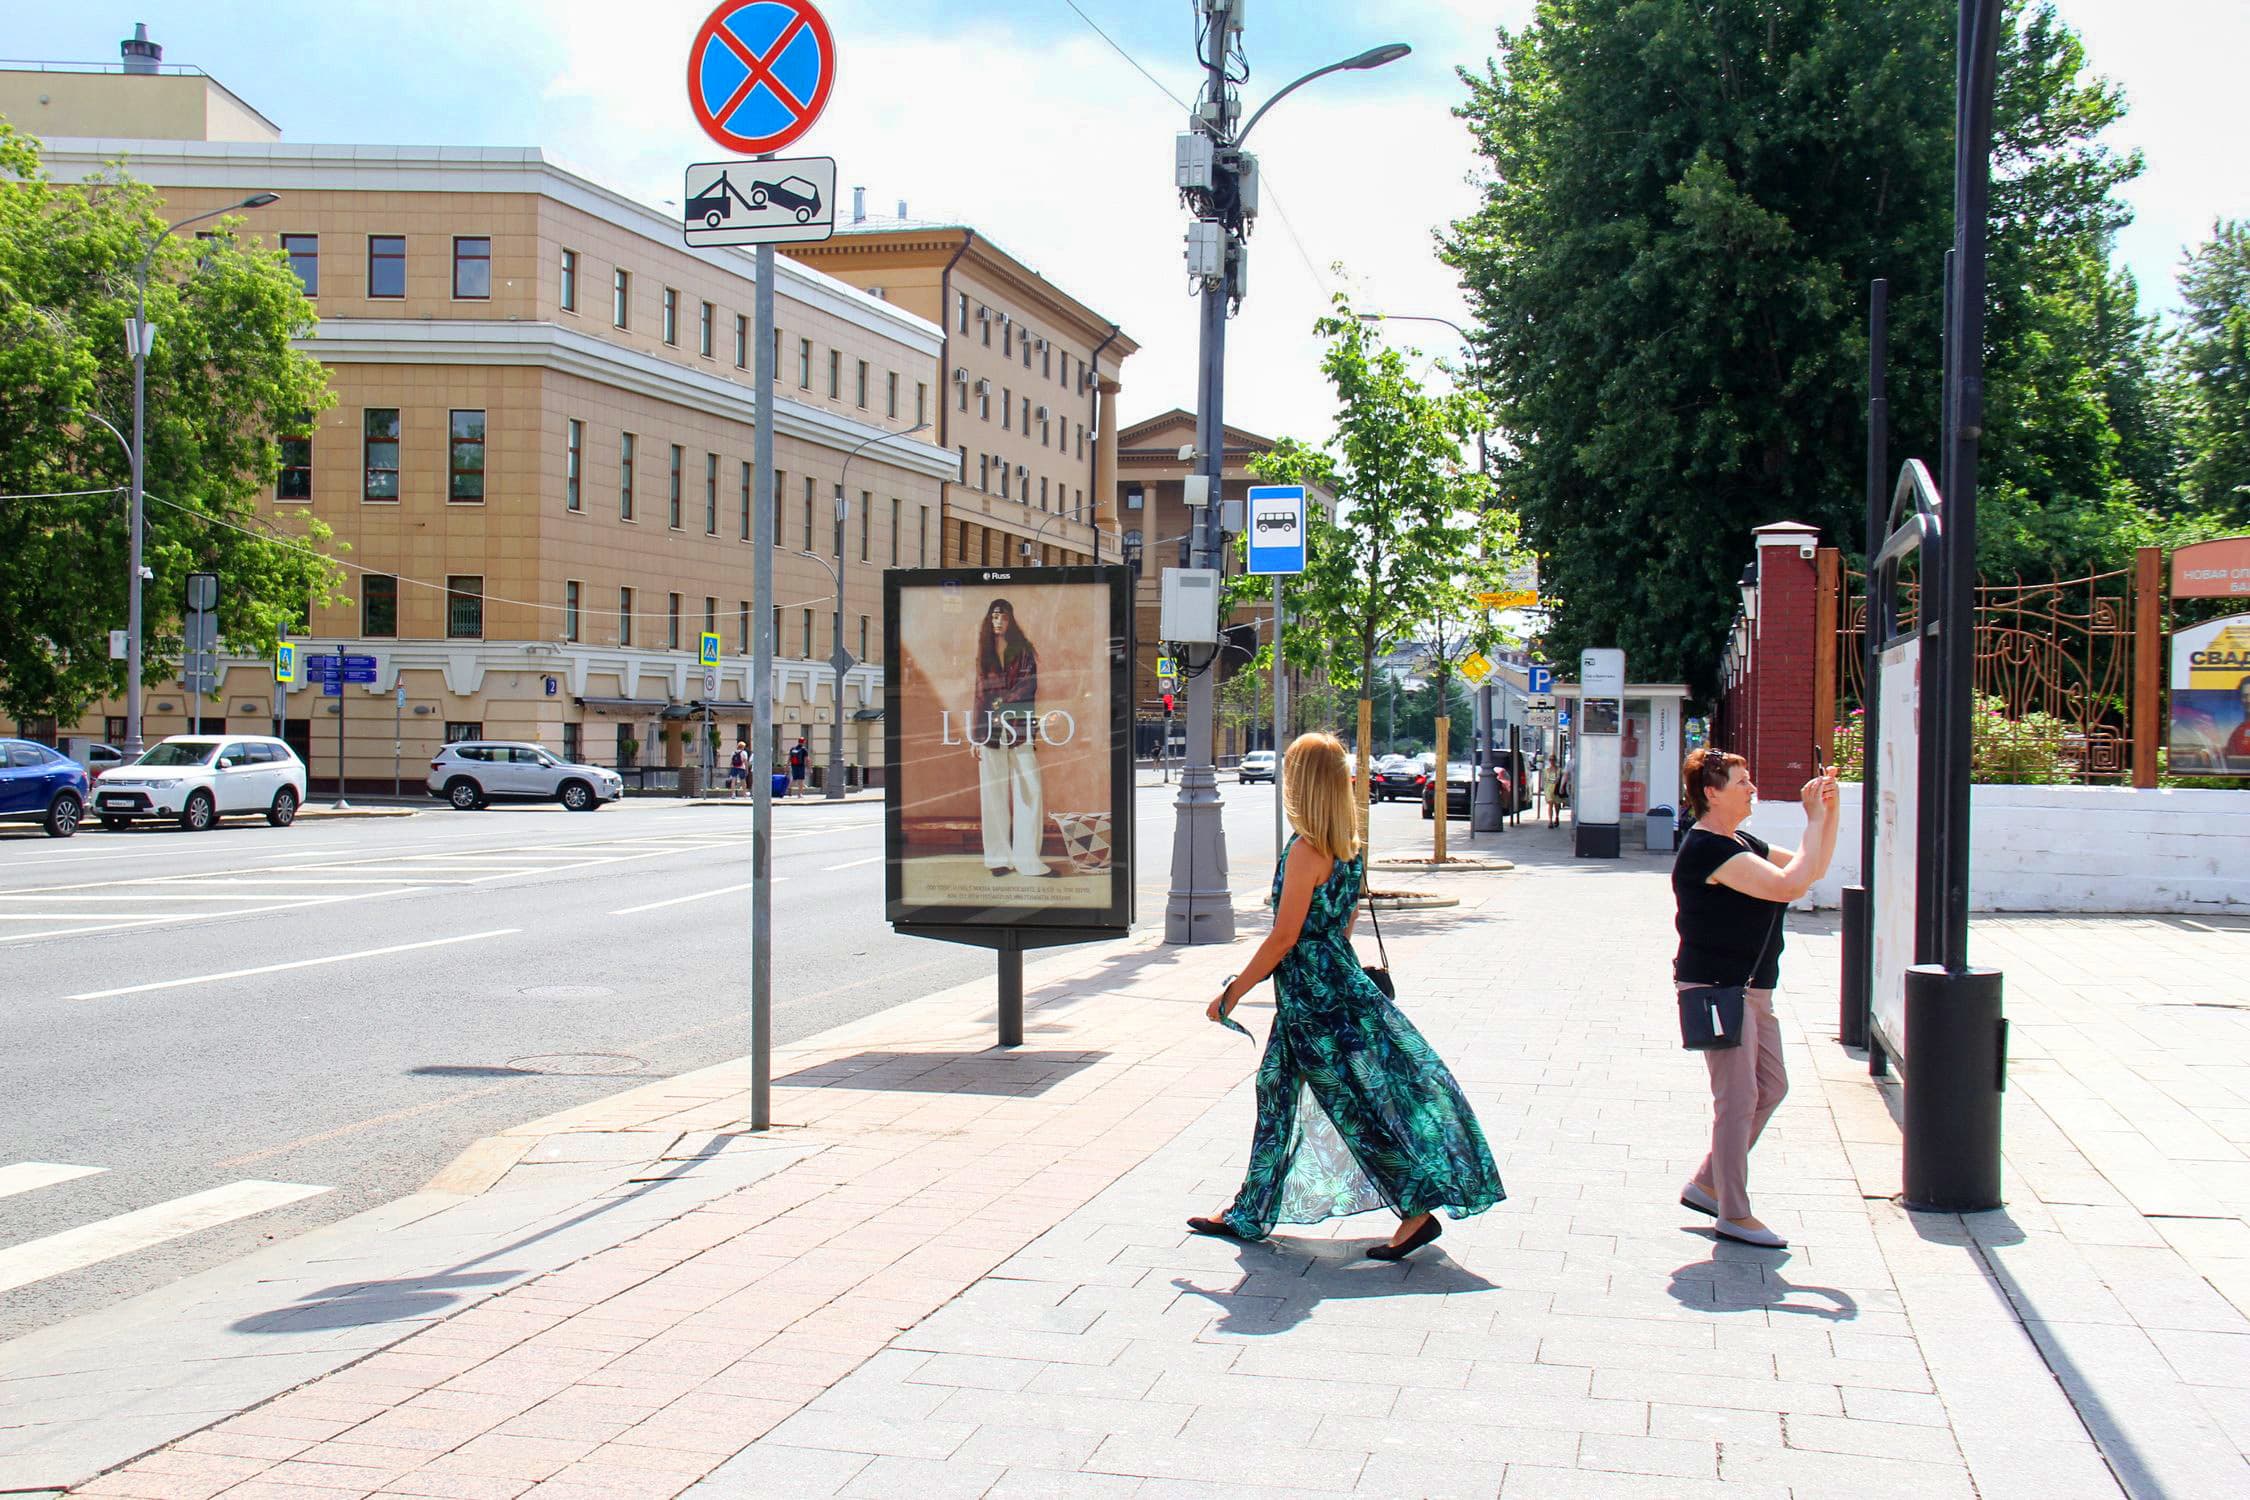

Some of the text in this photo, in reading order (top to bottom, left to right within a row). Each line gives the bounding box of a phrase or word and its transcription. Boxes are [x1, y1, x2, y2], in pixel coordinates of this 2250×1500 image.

[991, 572, 1011, 580] Russ
[2184, 569, 2228, 579] НОВАЯ
[1536, 669, 1551, 691] P
[550, 681, 555, 692] 2
[940, 710, 1075, 746] LUSIO
